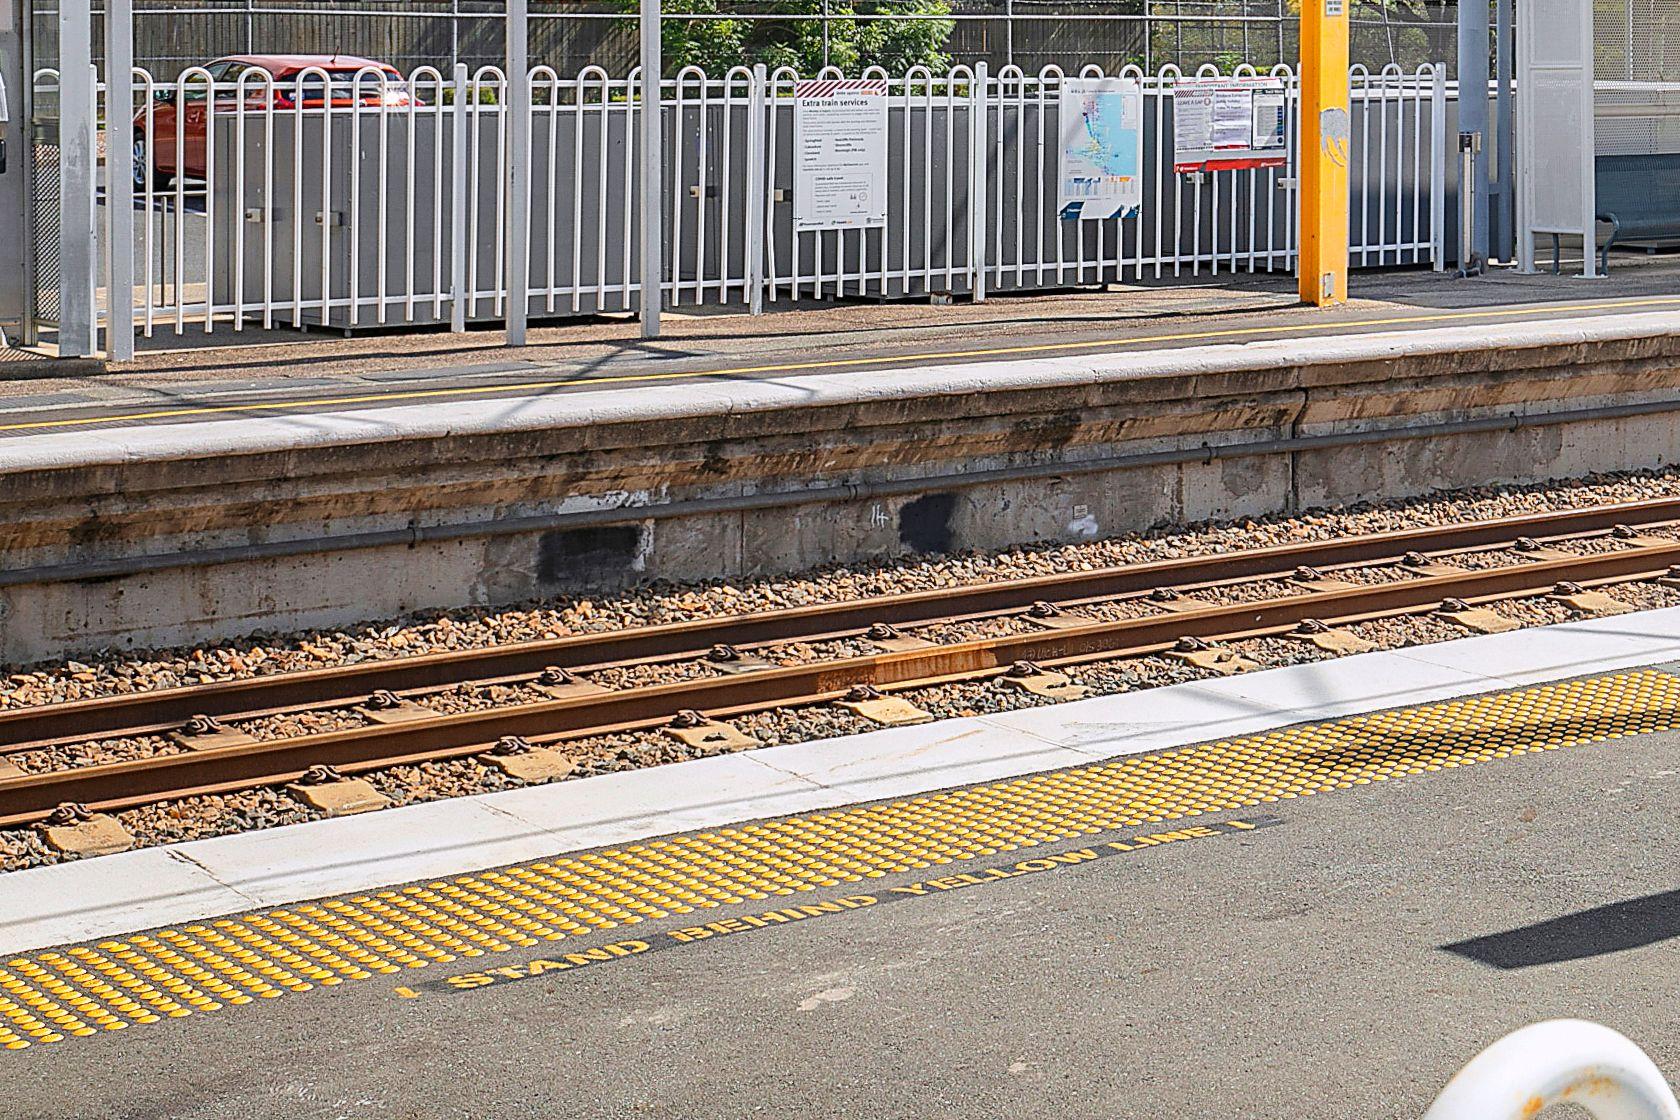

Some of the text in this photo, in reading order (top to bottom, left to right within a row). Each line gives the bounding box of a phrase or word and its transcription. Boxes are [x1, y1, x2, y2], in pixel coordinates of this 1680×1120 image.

[802, 97, 868, 107] Extra train services
[447, 826, 1222, 989] STAND BEHIND YELLOW LINE
